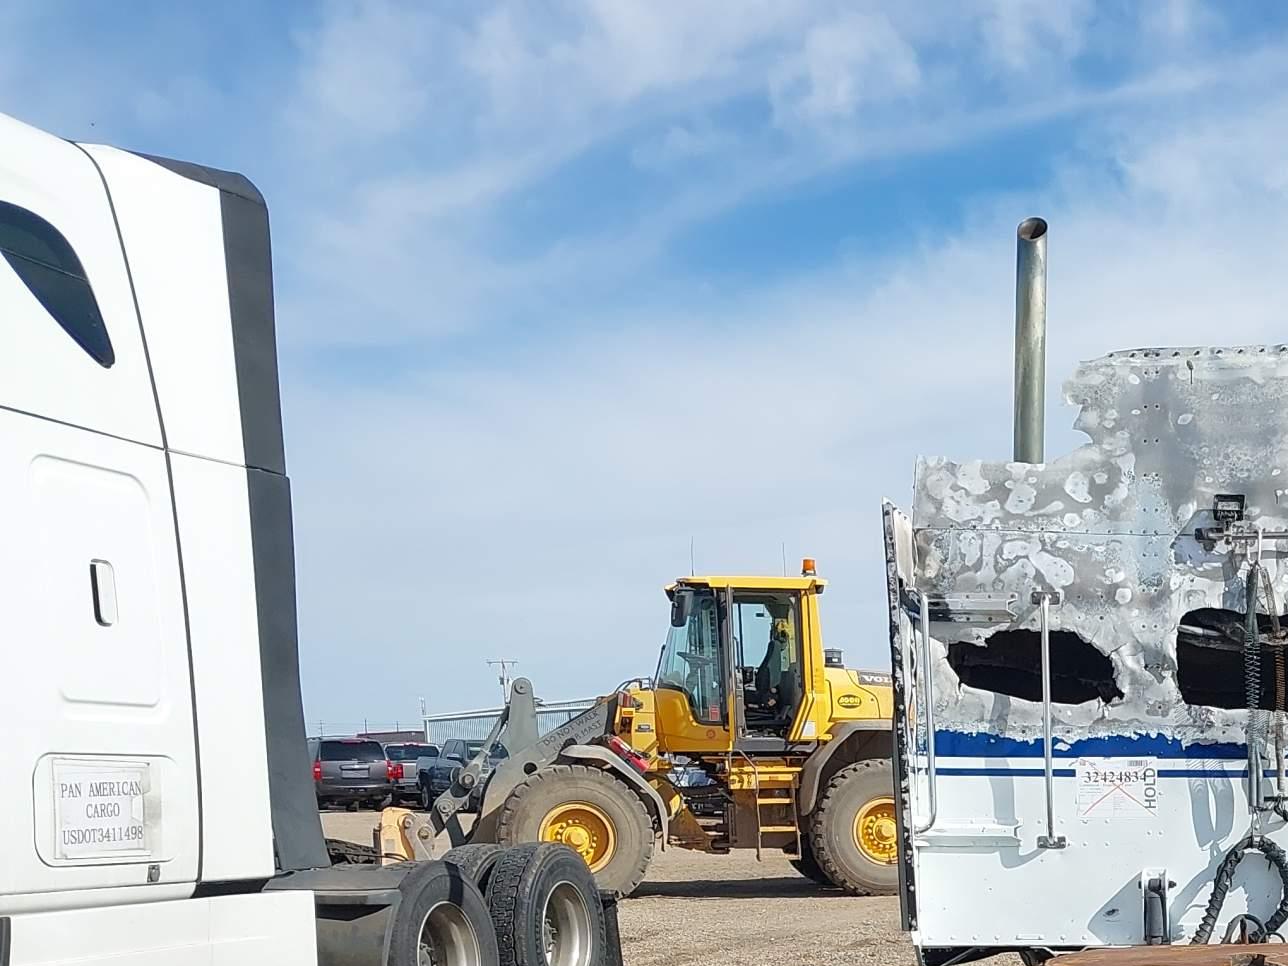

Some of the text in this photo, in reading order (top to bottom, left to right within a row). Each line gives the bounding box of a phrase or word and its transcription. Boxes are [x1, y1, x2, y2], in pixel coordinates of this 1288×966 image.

[542, 710, 600, 746] DO NOT WALK
[581, 719, 602, 737] MAST
[1083, 771, 1146, 783] 32424834
[60, 780, 142, 799] PAN AMERICAN
[1144, 767, 1157, 809] HOLD
[85, 802, 120, 819] CARGO
[62, 825, 145, 846] USDOT3411498
